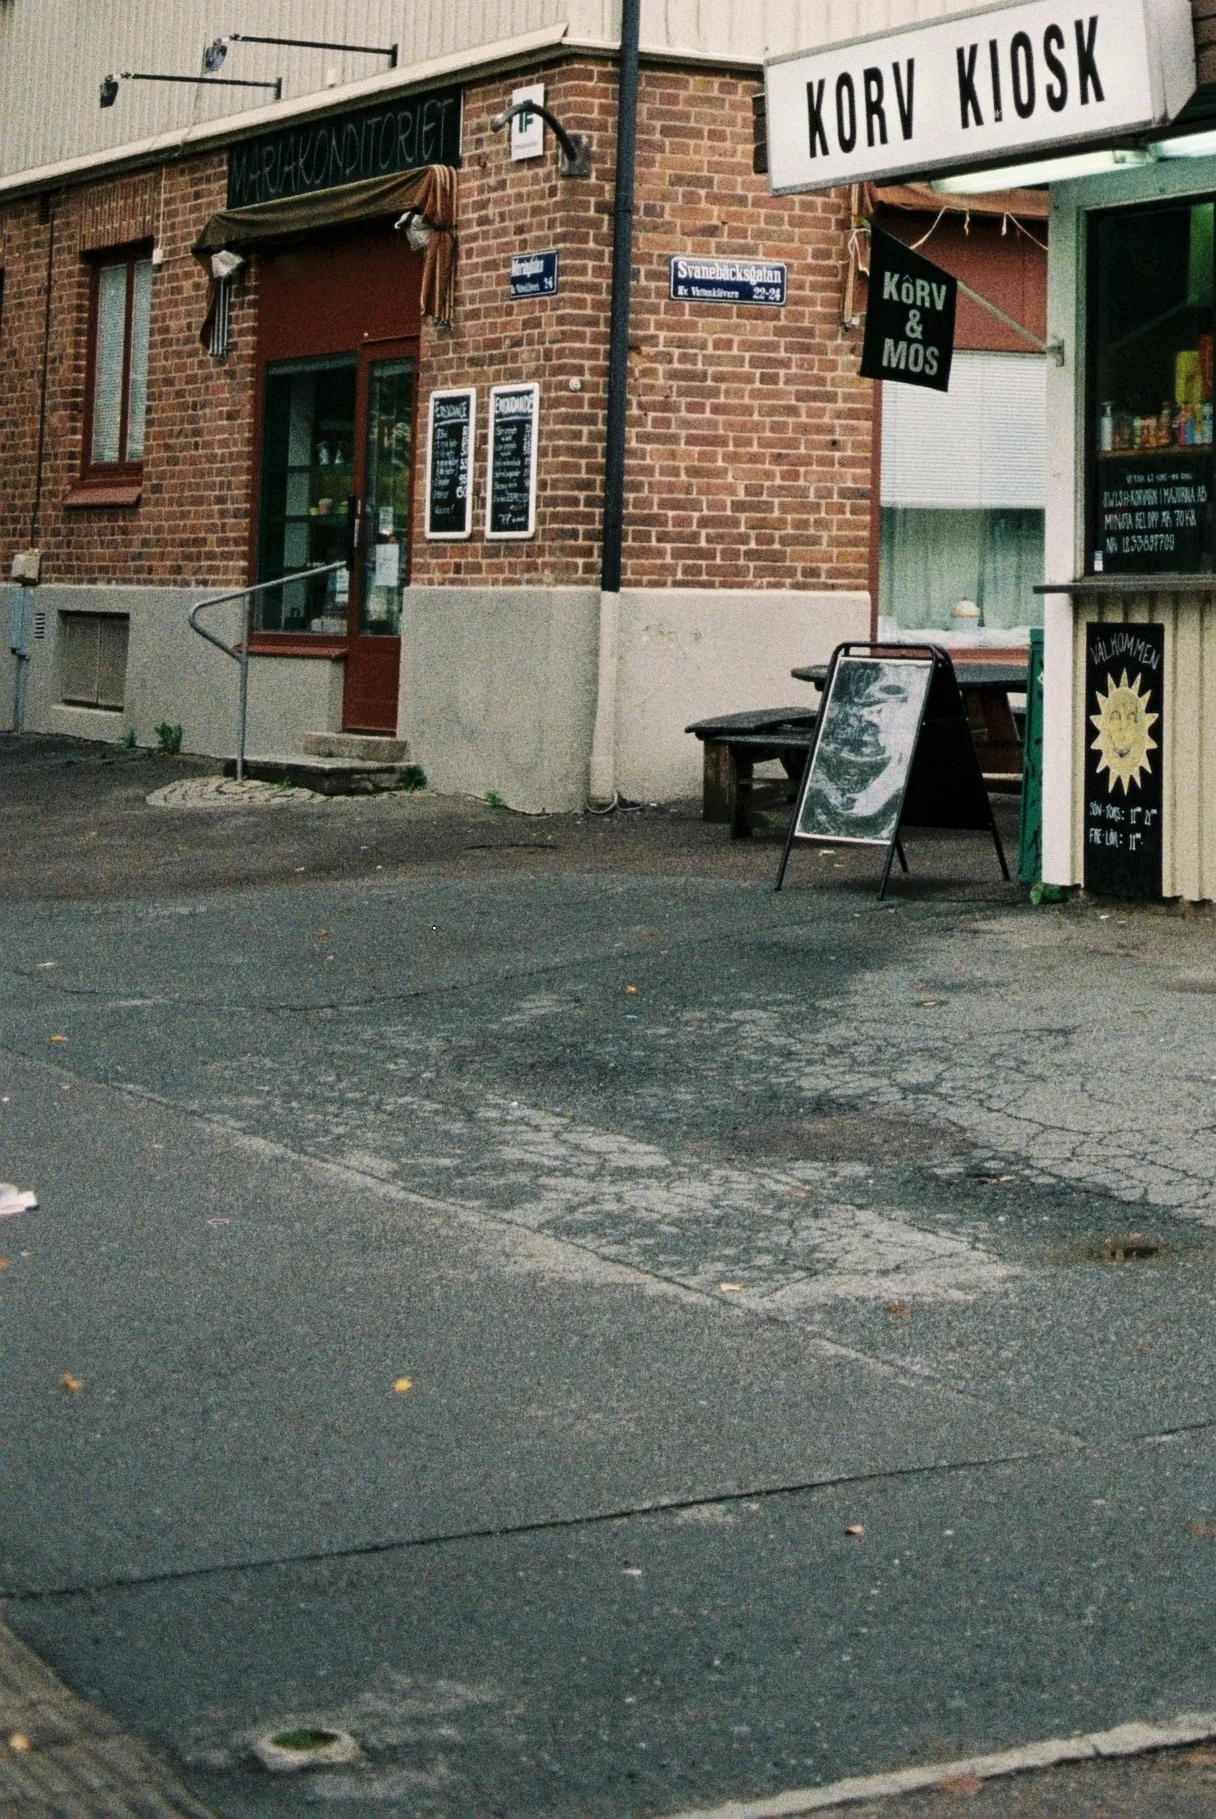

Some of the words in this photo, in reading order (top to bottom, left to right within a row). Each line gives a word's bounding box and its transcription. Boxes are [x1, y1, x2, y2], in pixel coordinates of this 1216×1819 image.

[806, 58, 915, 158] KORV
[956, 15, 1105, 129] KIOSK
[678, 261, 782, 286] Svanebäcksgatan
[752, 287, 781, 301] 22-24
[905, 309, 924, 339] &
[882, 340, 939, 376] MOS
[1090, 632, 1161, 669] VÄLKOMMEN
